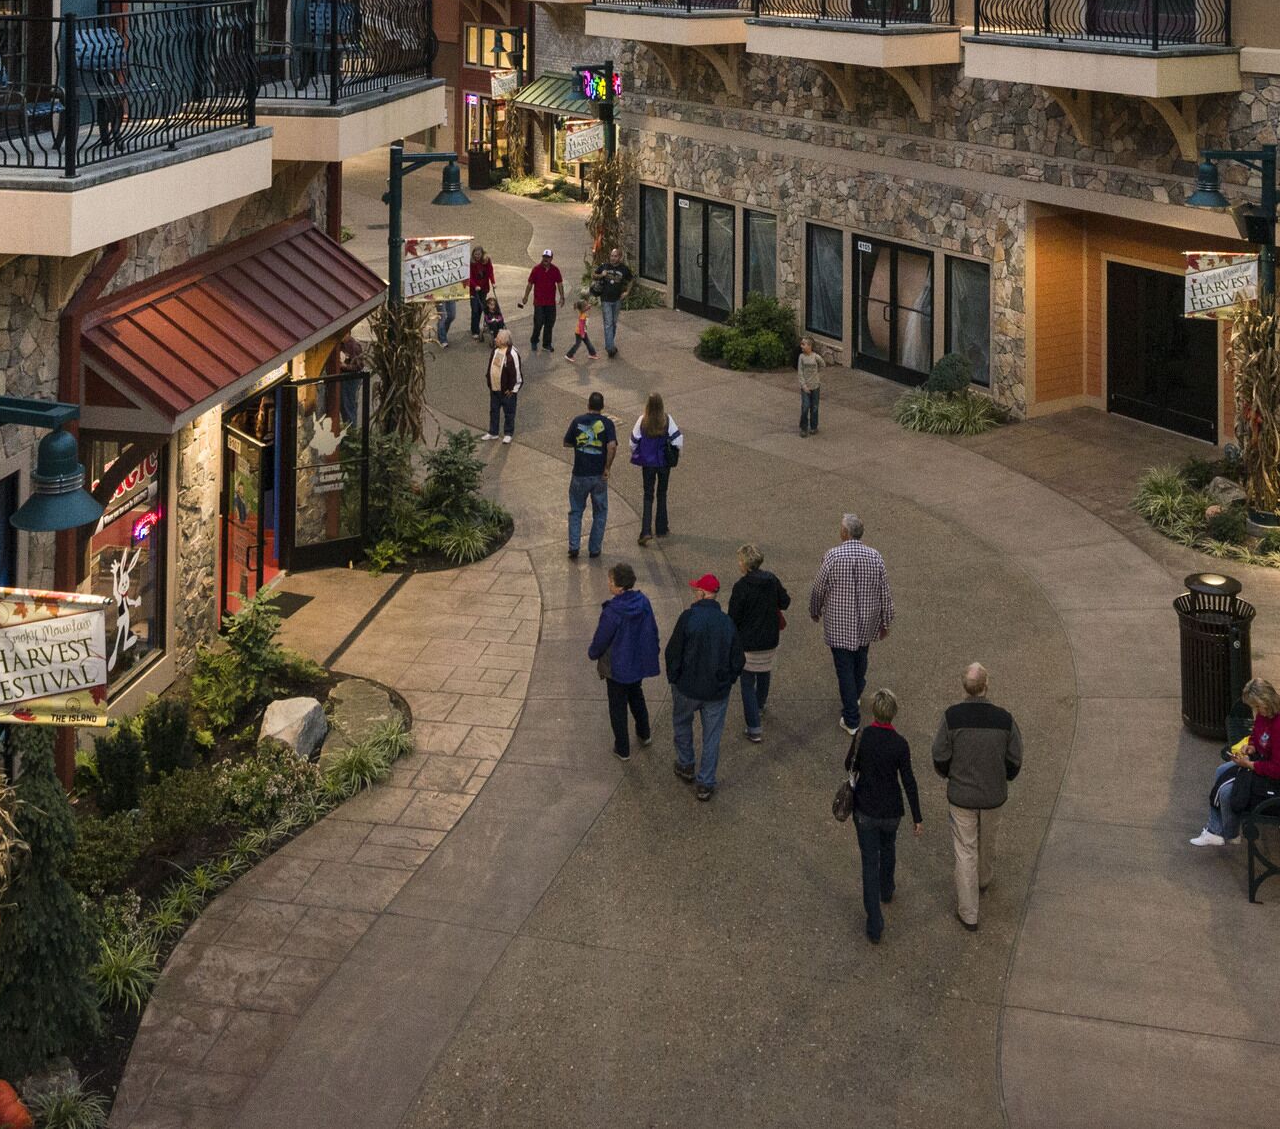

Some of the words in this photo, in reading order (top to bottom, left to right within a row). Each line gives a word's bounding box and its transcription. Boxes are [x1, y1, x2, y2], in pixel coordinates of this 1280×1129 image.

[408, 269, 465, 294] FESTIVAL
[409, 256, 465, 284] HARVEST
[1190, 275, 1250, 297] HARVEST
[1190, 290, 1244, 311] FESTIV
[5, 628, 38, 651] Smoky
[40, 619, 92, 641] Mountain
[51, 713, 66, 722] THE
[68, 714, 98, 723] ISLAND
